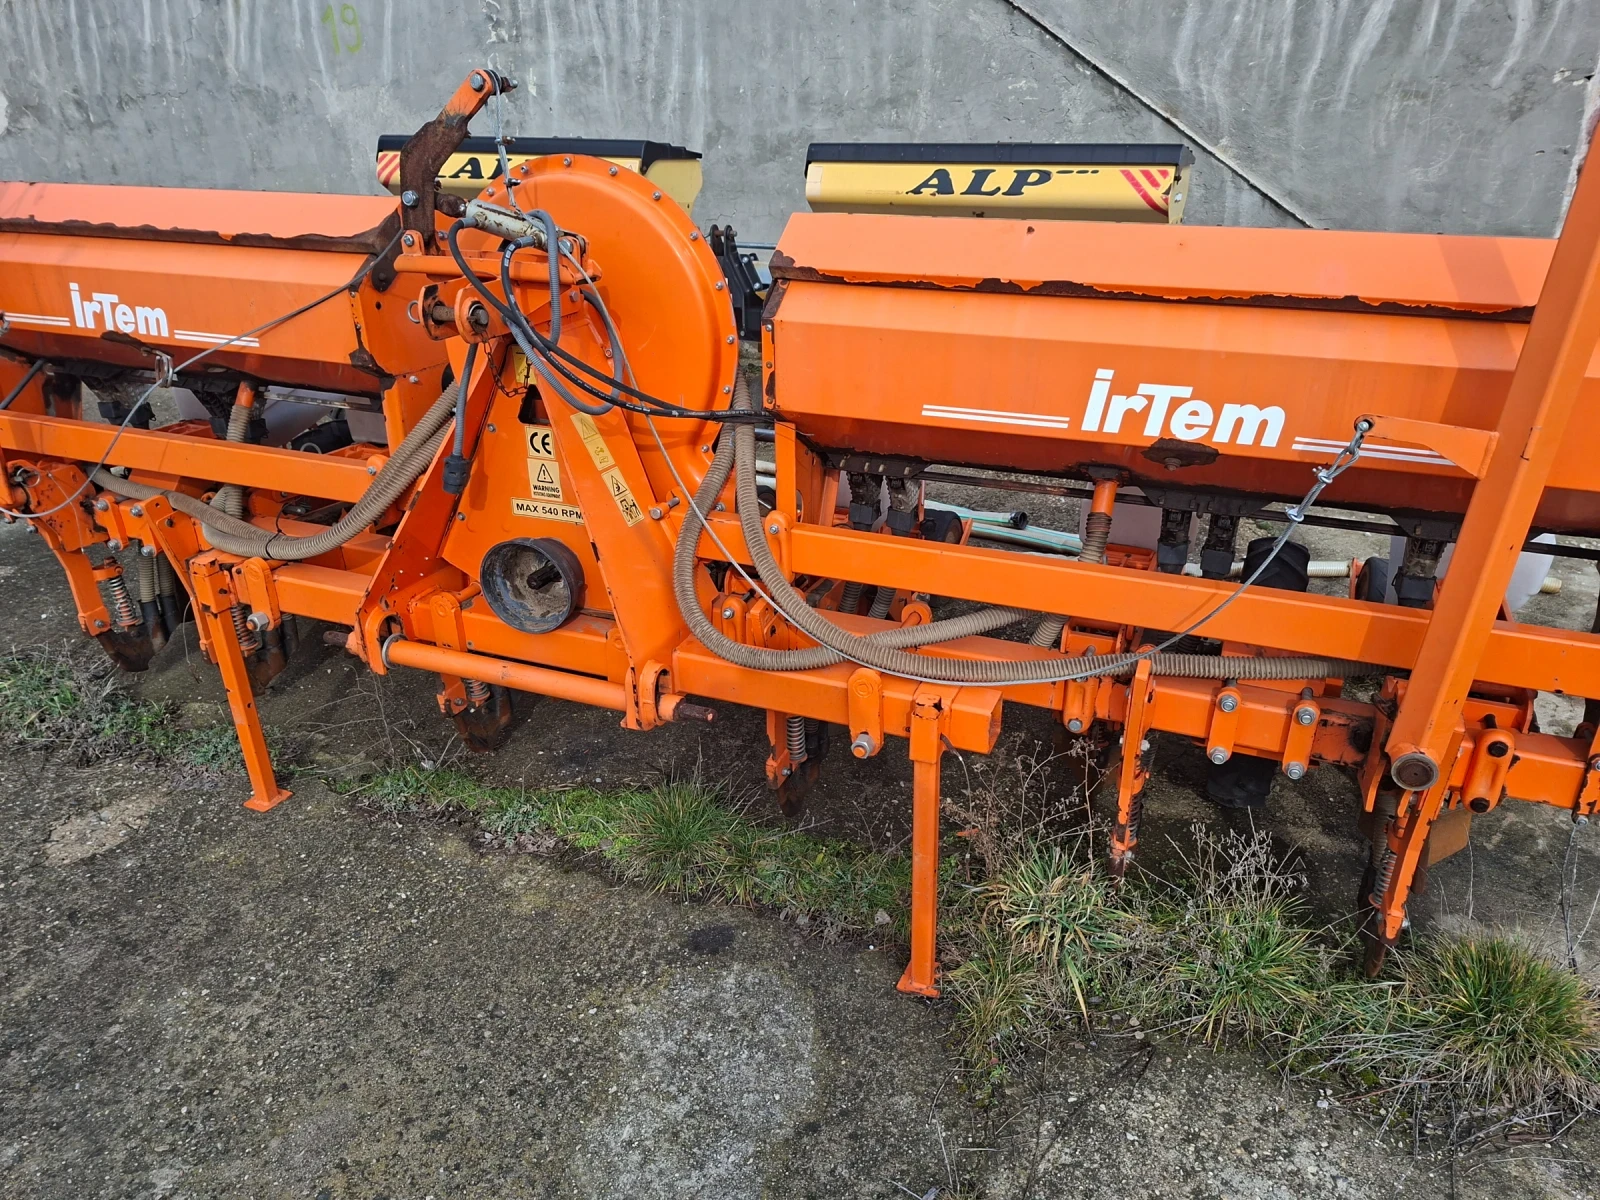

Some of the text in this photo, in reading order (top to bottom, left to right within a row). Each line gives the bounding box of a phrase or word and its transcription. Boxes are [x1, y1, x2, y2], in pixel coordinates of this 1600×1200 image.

[321, 3, 362, 55] 19
[905, 168, 1053, 196] ALP
[529, 431, 552, 455] CE
[532, 484, 560, 494] WARNING
[516, 503, 539, 513] MAX
[541, 506, 559, 516] 540
